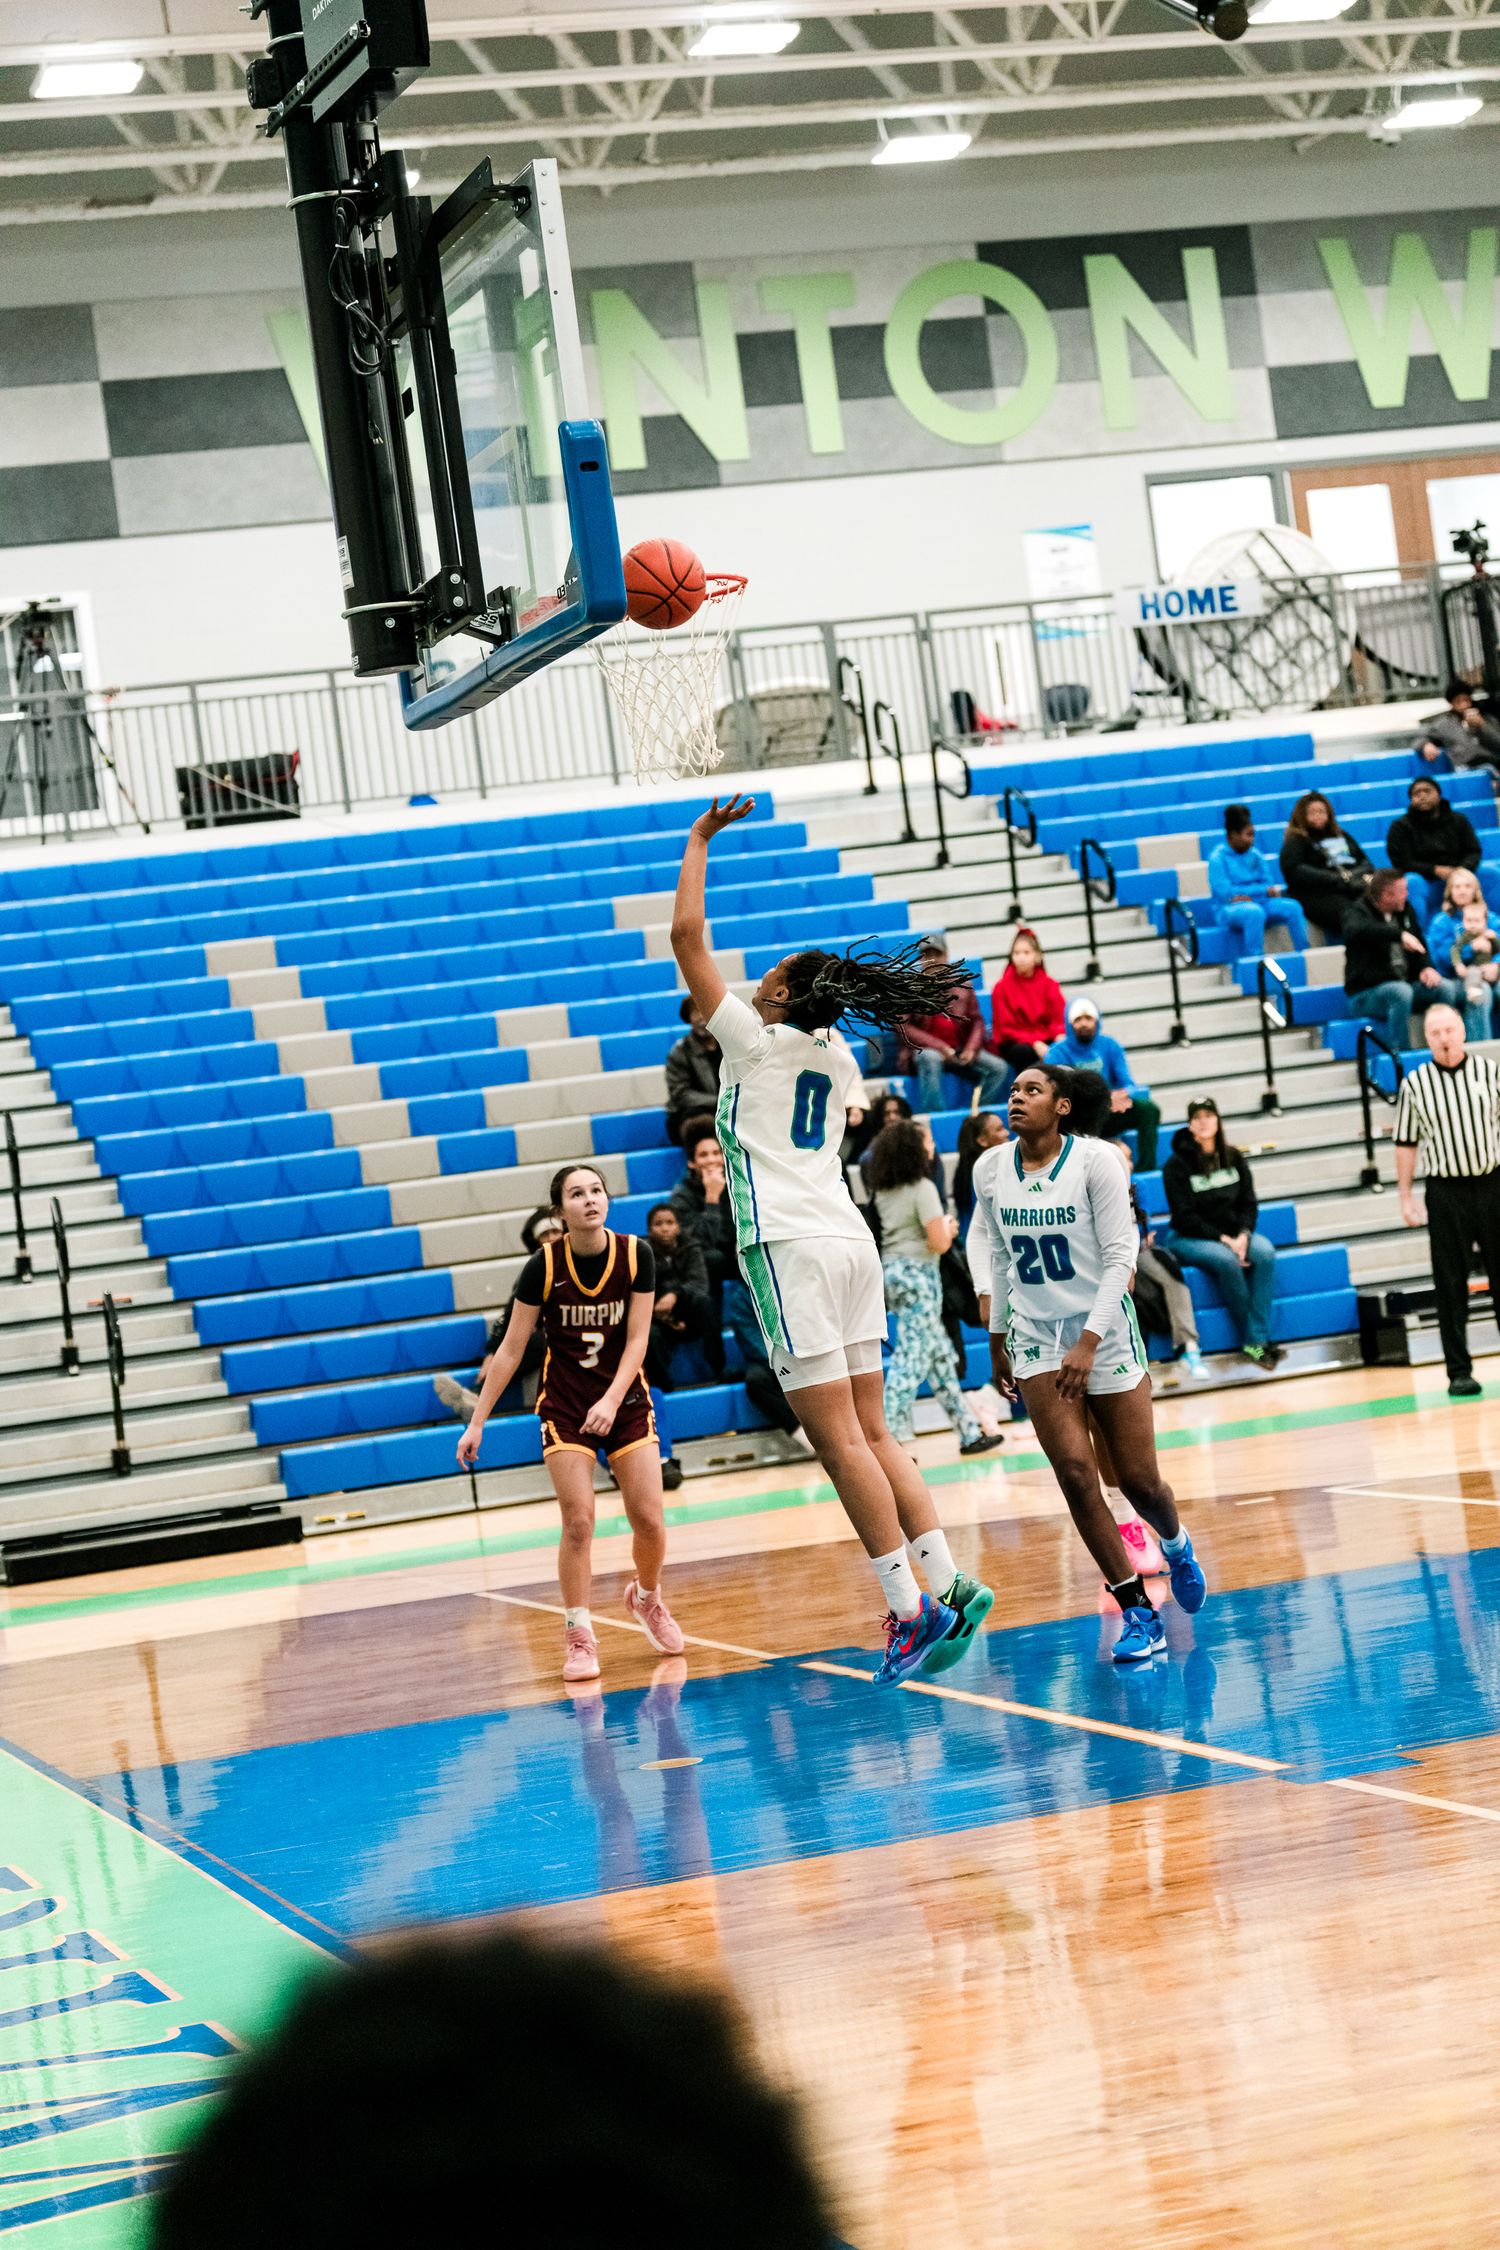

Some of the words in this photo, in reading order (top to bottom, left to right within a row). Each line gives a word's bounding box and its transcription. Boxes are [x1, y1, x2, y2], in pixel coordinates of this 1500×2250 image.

[1139, 585, 1238, 620] HOME
[790, 1069, 833, 1152] 0
[1000, 1205, 1076, 1227] WARRIORS
[1010, 1233, 1076, 1285] 20
[559, 1299, 625, 1327] TURPIN
[579, 1332, 605, 1369] 3
